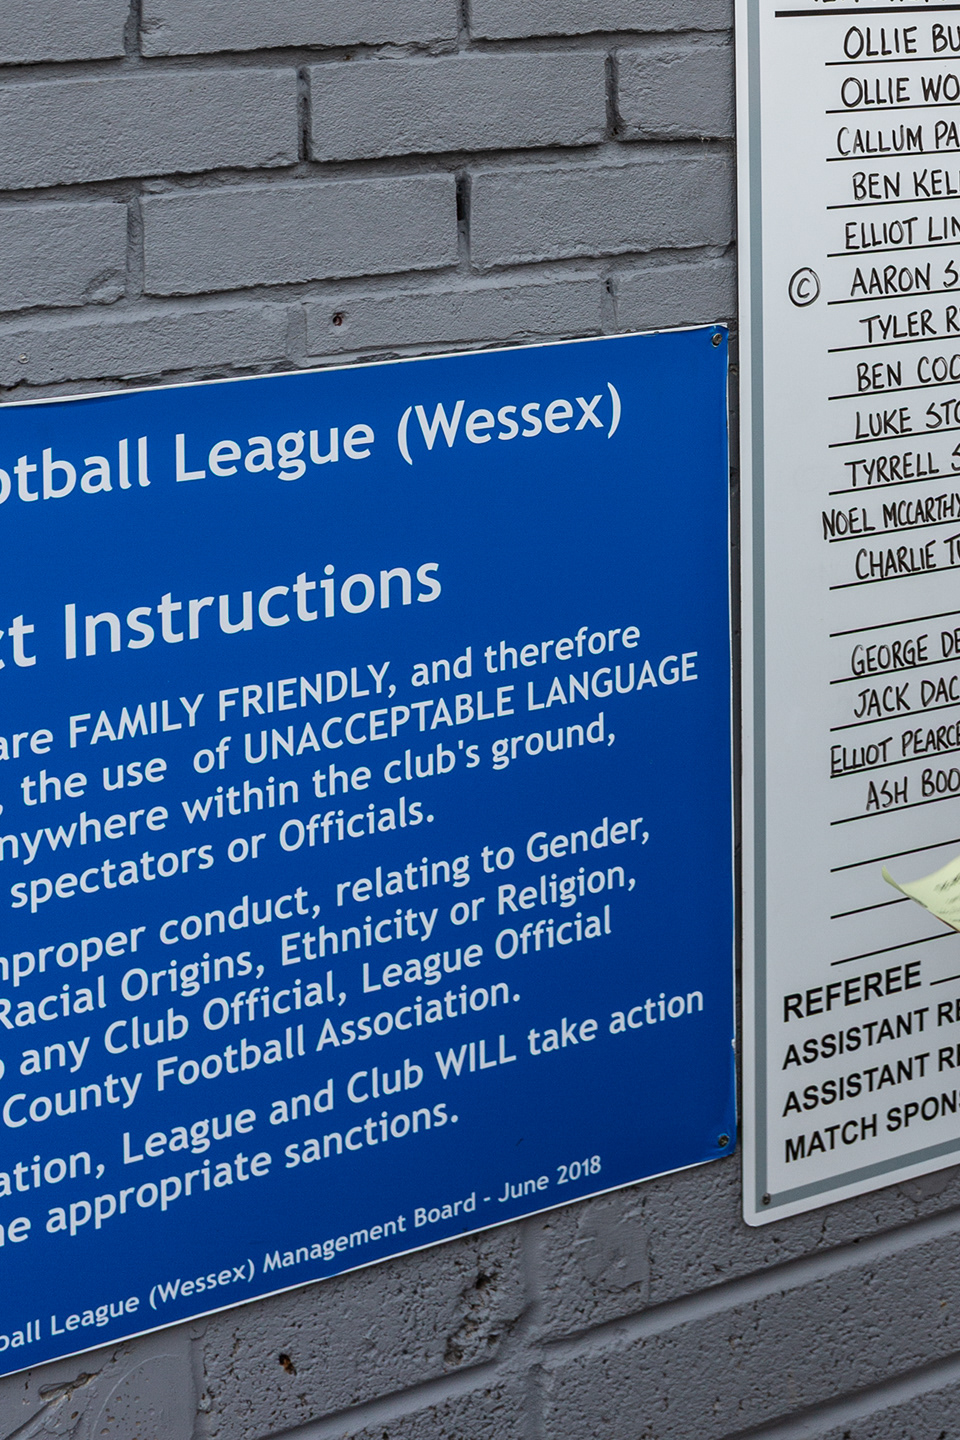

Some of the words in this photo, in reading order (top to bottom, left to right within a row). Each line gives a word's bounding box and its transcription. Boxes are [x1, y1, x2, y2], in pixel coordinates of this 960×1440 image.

[843, 25, 917, 59] OLLIE
[840, 77, 910, 108] OLLIE
[837, 124, 923, 157] CALLUM
[852, 171, 901, 201] BEN
[845, 217, 918, 250] ELLIOT
[850, 263, 931, 296] AARON
[859, 309, 937, 343] TYLER
[856, 361, 901, 392] BEN
[175, 421, 375, 482] League
[397, 381, 622, 465] (Wessex)
[855, 407, 912, 440] LUKE
[844, 451, 940, 487] TYRRELL
[821, 507, 876, 540] NOEL
[855, 540, 937, 580] CHARLIE
[64, 561, 443, 660] Instructions
[851, 634, 929, 676] GEORGE
[69, 693, 205, 748] FAMILY
[218, 661, 397, 722] FRIENDLY,
[411, 646, 473, 687] and
[484, 625, 641, 674] therefore
[854, 683, 911, 718] JACK
[21, 769, 87, 806] the
[103, 757, 167, 791] use
[193, 736, 232, 774] of
[245, 685, 515, 764] UNACCEPTABLE
[527, 651, 698, 711] LANGUAGE
[181, 776, 299, 824] within
[313, 763, 371, 799] the
[384, 740, 480, 784] club's
[492, 712, 616, 770] ground,
[830, 737, 893, 776] ELLIOT
[866, 776, 908, 811] ASH
[783, 960, 922, 1023] REFEREE
[785, 1113, 877, 1164] MATCH
[51, 1295, 140, 1335] League
[149, 1259, 256, 1310] (Wessex)
[262, 1216, 407, 1274] Management
[414, 1192, 476, 1228] Board
[498, 1174, 549, 1203] June
[556, 1155, 602, 1186] 2018
